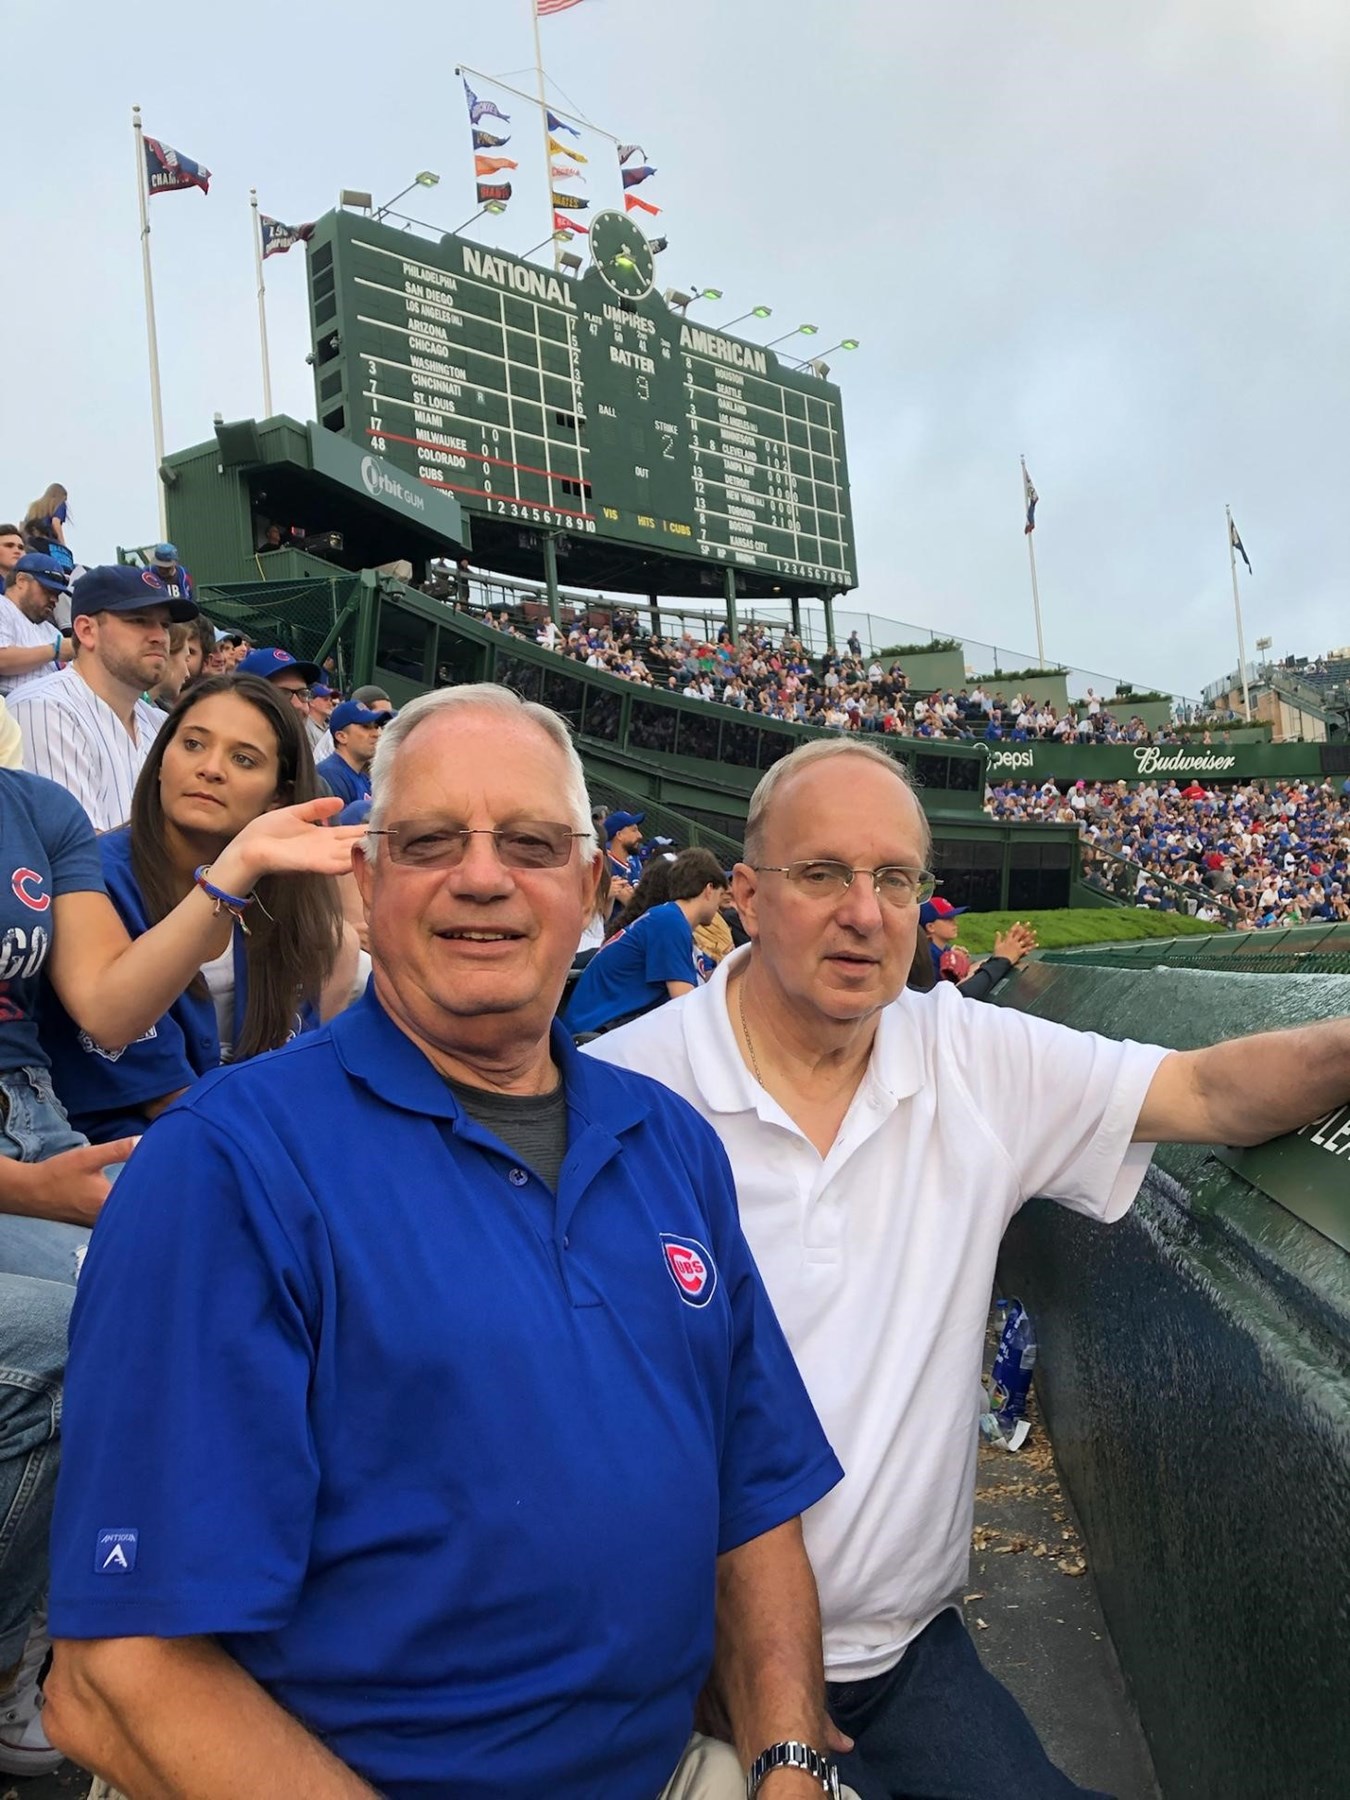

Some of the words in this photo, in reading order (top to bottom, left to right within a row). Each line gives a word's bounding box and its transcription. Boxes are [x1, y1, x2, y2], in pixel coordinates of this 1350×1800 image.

[403, 262, 458, 291] PHILADELPHIA
[462, 246, 577, 310] NATIONAL
[405, 281, 424, 300] SAN
[425, 287, 454, 306] DIEGO
[406, 299, 420, 314] LOS
[421, 304, 450, 324] ANGELES
[584, 312, 602, 325] PLATE
[603, 304, 656, 335] UMPIRES
[408, 318, 448, 340] ARIZONA
[571, 318, 576, 330] 7
[409, 336, 449, 358] CHICAGO
[572, 335, 578, 347] 5
[680, 324, 767, 375] AMERICAN
[573, 352, 579, 364] 2
[610, 346, 655, 375] BATTER
[368, 360, 377, 375] 3
[410, 354, 467, 380] WASHINGTON
[574, 368, 580, 380] 3
[411, 373, 462, 397] CINCINNATI
[687, 372, 693, 384] 9
[714, 368, 744, 386] HOUSTON
[369, 379, 376, 393] 7
[576, 384, 582, 397] 4
[688, 388, 694, 400] 7
[716, 383, 742, 400] SEATTLE
[413, 392, 426, 405] ST.
[428, 395, 455, 413] LOUIS
[577, 402, 584, 414] 6
[690, 404, 696, 415] 3
[718, 398, 747, 416] OAKLAND
[414, 410, 442, 428] MIAMI
[598, 404, 616, 418] BALL
[719, 413, 729, 424] LOS
[370, 416, 382, 431] 17
[654, 420, 678, 436] STRIKE
[416, 428, 468, 452] MILWAUKEE
[482, 426, 486, 440] 1
[492, 428, 499, 442] 0
[693, 435, 698, 446] 3
[720, 428, 756, 447] MINNESOTA
[370, 436, 386, 452] 48
[482, 444, 488, 457] 0
[494, 446, 498, 460] 1
[662, 434, 674, 459] 2
[710, 440, 716, 450] 8
[765, 441, 770, 452] 0
[772, 442, 778, 454] 4
[418, 447, 466, 469] COLORADO
[694, 450, 700, 462] 7
[722, 444, 758, 462] CLEVELAND
[482, 462, 490, 475] 0
[635, 466, 649, 478] OUT
[693, 465, 704, 478] 13
[744, 465, 755, 476] BAY
[774, 458, 780, 469] 0
[782, 460, 788, 471] 2
[418, 466, 444, 482] CUBS
[724, 474, 750, 489] DETROIT
[768, 471, 772, 482] 0
[776, 473, 781, 484] 0
[792, 477, 797, 488] 0
[361, 456, 403, 500] Orbit
[404, 490, 424, 511] GUM
[484, 480, 492, 493] 0
[694, 481, 705, 494] 12
[696, 496, 706, 509] 13
[726, 489, 740, 502] NEW
[740, 493, 755, 506] YORK
[768, 486, 774, 496] 0
[777, 487, 782, 498] 0
[785, 490, 790, 500] 0
[793, 492, 798, 503] 0
[487, 498, 492, 512] 1
[498, 501, 506, 514] 2
[511, 503, 518, 516] 3
[522, 506, 528, 518] 4
[532, 508, 540, 521] 5
[543, 510, 551, 523] 6
[555, 512, 562, 526] 7
[566, 514, 573, 528] 8
[576, 517, 584, 530] 9
[586, 519, 596, 533] 10
[728, 504, 756, 520] TORONTO
[770, 500, 776, 512] 0
[778, 502, 784, 513] 0
[786, 504, 792, 515] 0
[603, 508, 618, 520] VIS
[638, 515, 656, 528] HITS
[670, 522, 692, 536] CUBS
[699, 514, 706, 524] 8
[728, 520, 754, 534] BOSTON
[772, 515, 778, 526] 2
[788, 519, 793, 530] 0
[795, 521, 801, 532] 0
[700, 528, 707, 540] 7
[700, 545, 710, 556] SP
[730, 535, 754, 550] KANSAS
[754, 540, 768, 552] CITY
[776, 560, 780, 571] 1
[784, 562, 790, 572] 2
[792, 564, 798, 574] 3
[799, 566, 805, 576] 4
[807, 568, 813, 578] 5
[815, 570, 820, 580] 6
[822, 571, 828, 581] 7
[830, 573, 836, 582] 8
[838, 574, 843, 584] 9
[844, 576, 852, 586] 10
[993, 749, 1034, 770] pepsi
[1134, 746, 1236, 774] Budweiser
[12, 867, 50, 912] C
[665, 1244, 707, 1295] CUBS
